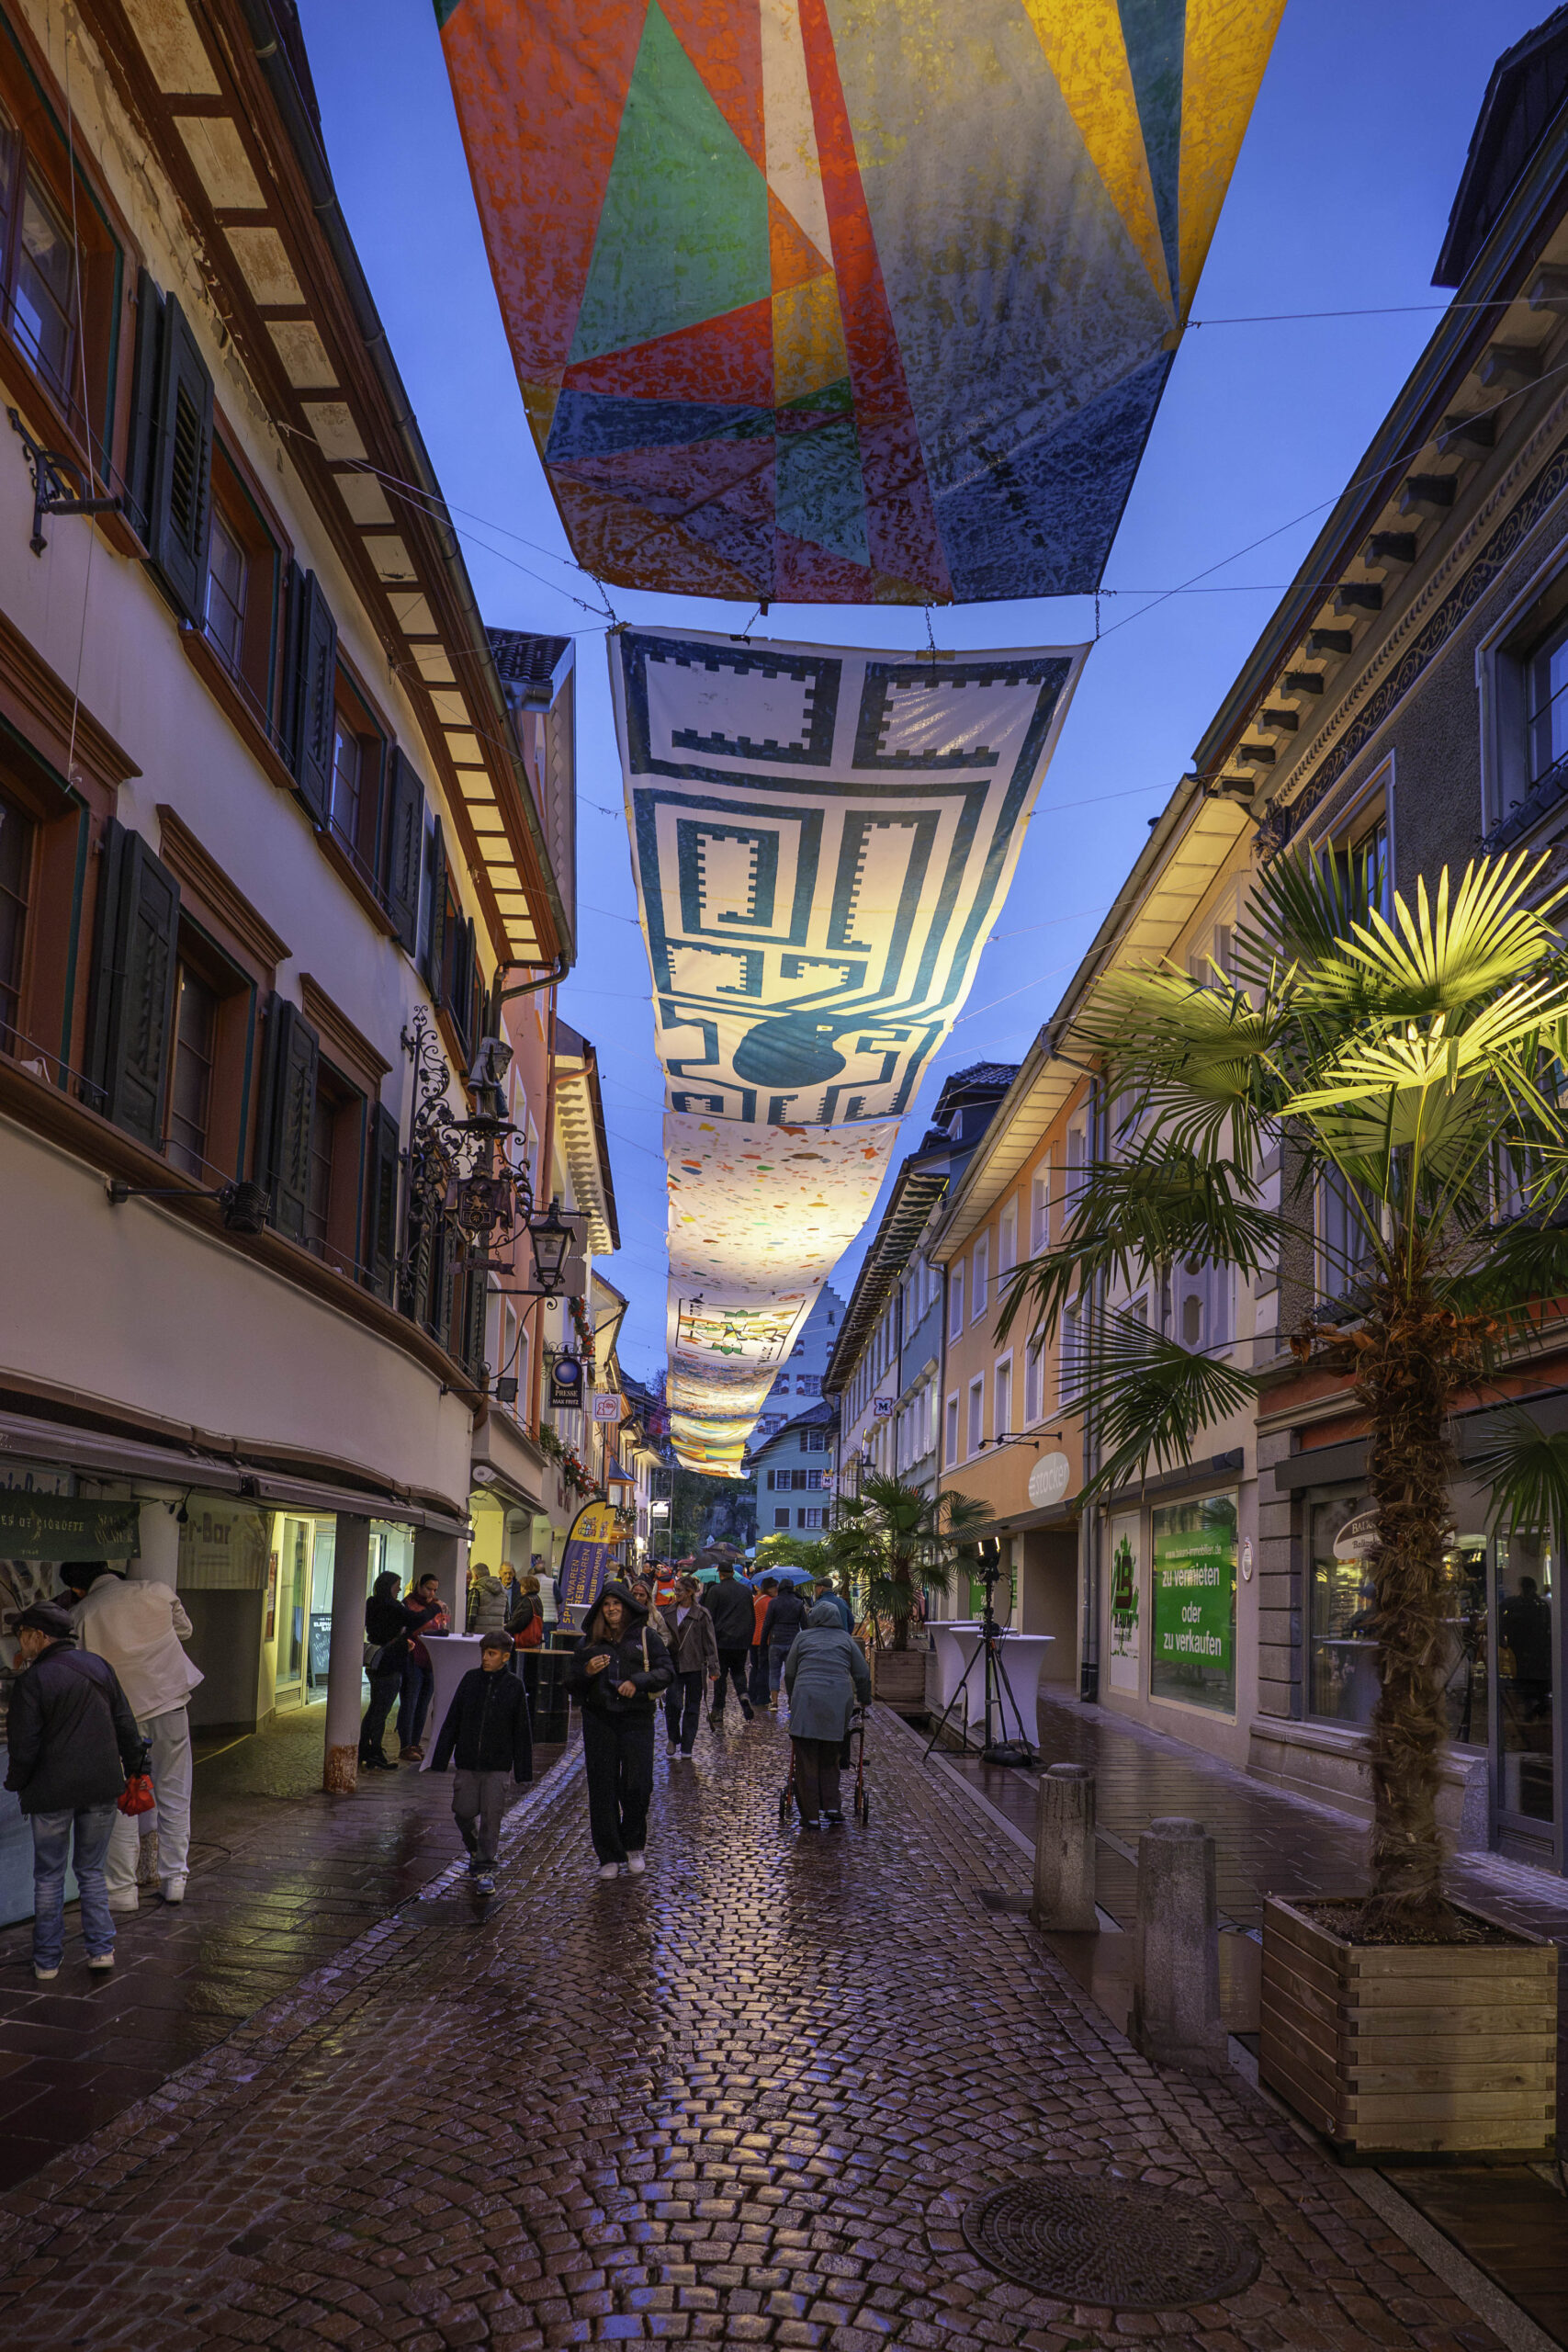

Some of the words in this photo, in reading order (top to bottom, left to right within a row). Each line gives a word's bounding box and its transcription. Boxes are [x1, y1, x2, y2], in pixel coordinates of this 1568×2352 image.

[588, 1548, 604, 1605] HREIBWAREN
[1162, 1570, 1172, 1588] zu
[1174, 1563, 1220, 1588] vermieten
[1181, 1600, 1201, 1623] oder
[1163, 1633, 1173, 1650] zu
[1175, 1629, 1222, 1657] verkaufen
